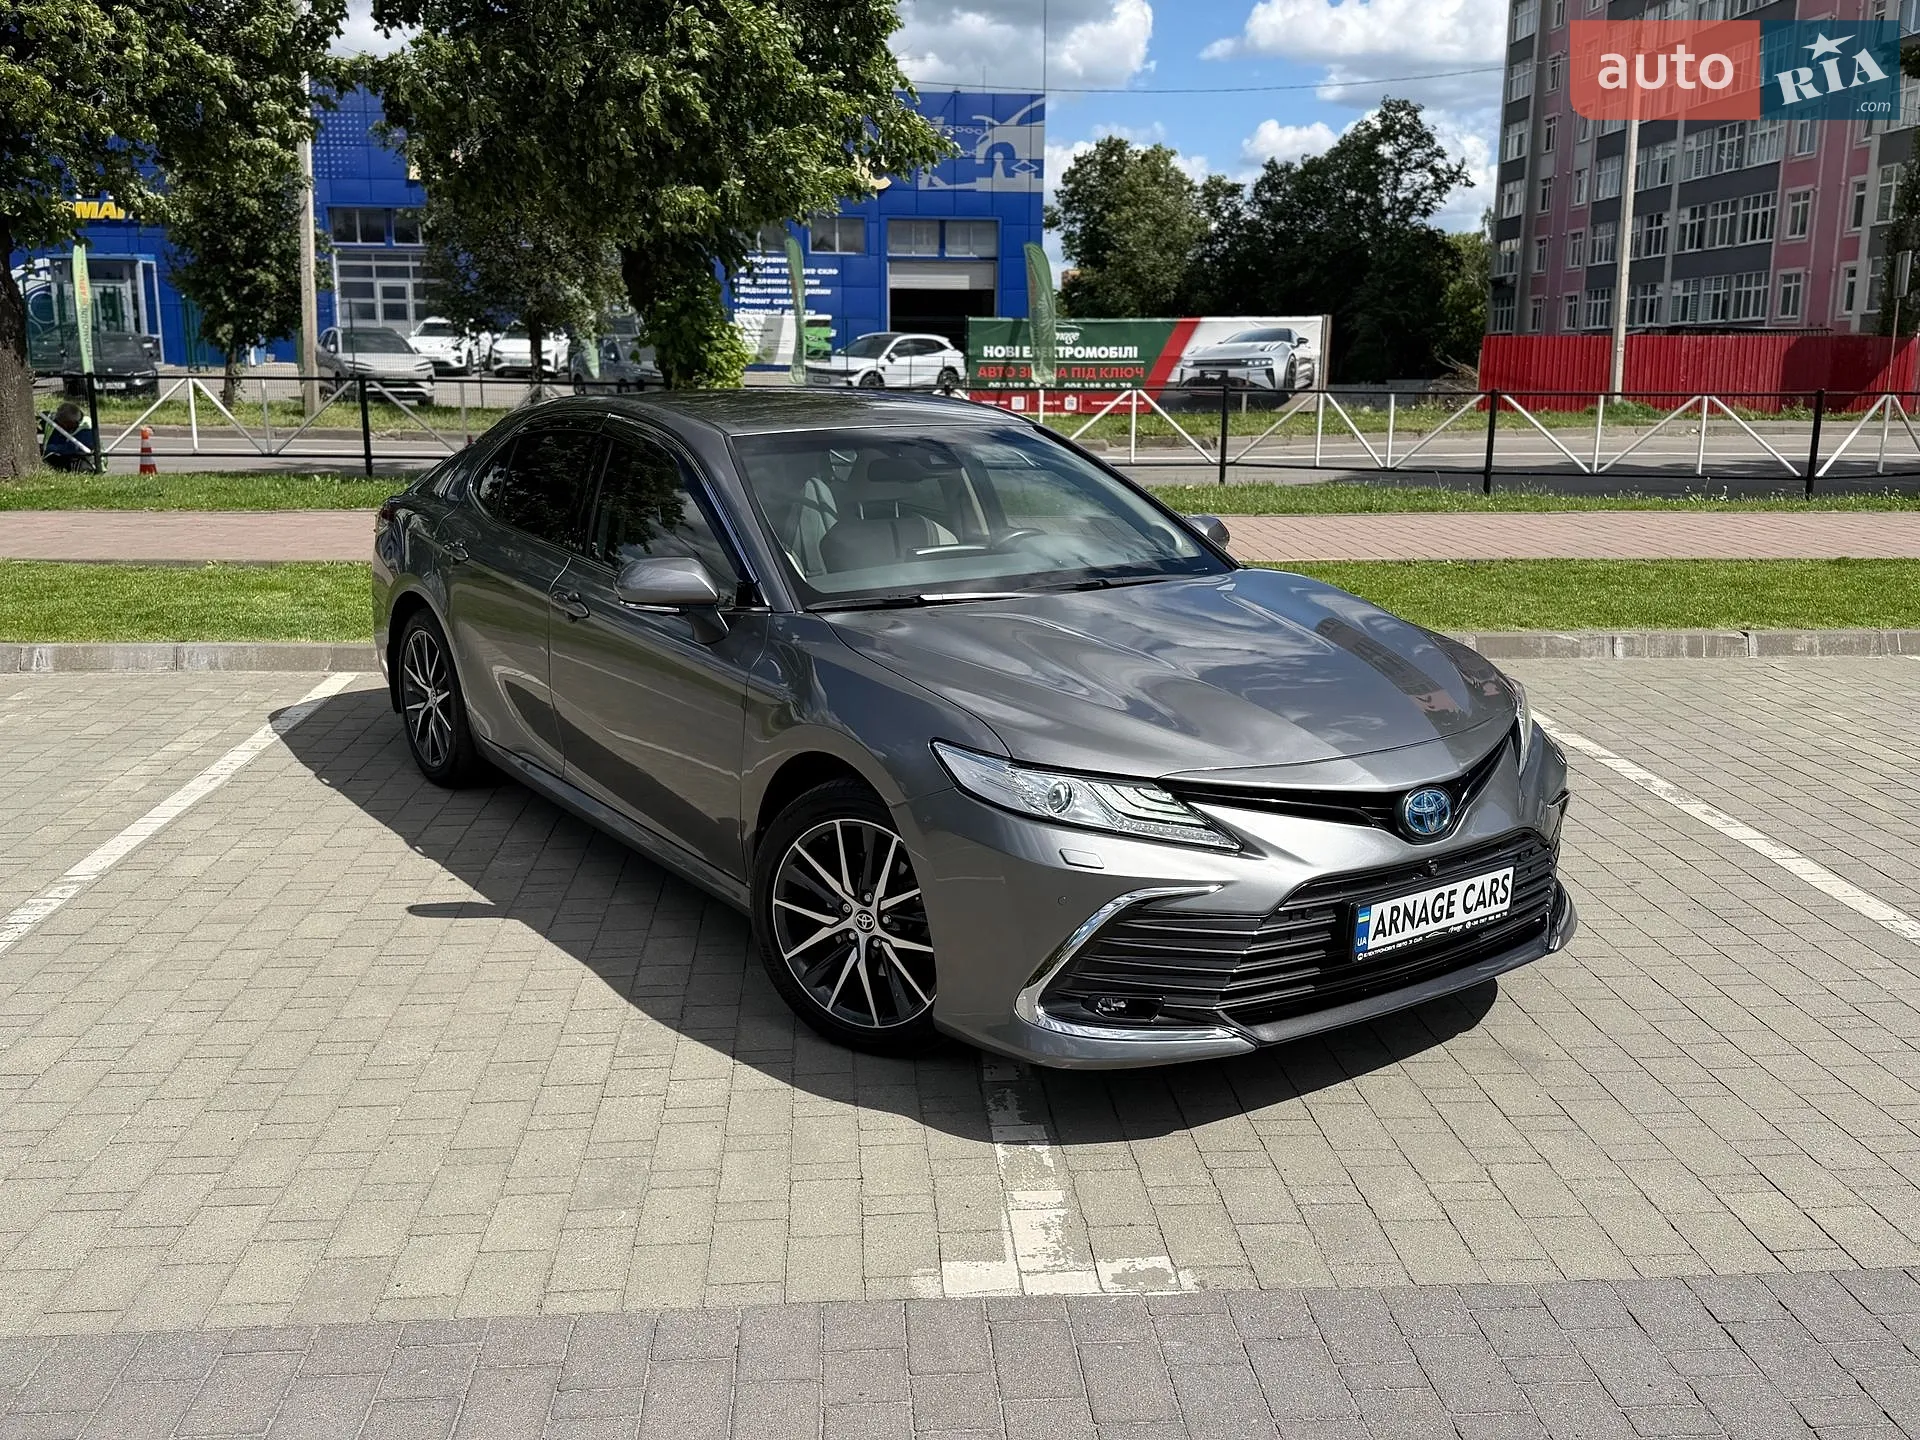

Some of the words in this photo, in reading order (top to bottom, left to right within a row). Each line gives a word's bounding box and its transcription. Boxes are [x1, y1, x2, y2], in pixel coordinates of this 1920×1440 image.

[983, 346, 1019, 358] НОВІ
[977, 366, 1016, 378] АВТО
[1071, 366, 1097, 379] ПІД
[1099, 366, 1144, 378] КЛЮЧ
[1371, 888, 1457, 942] ARNAGE
[1462, 873, 1510, 914] CARS
[1357, 936, 1367, 947] UA
